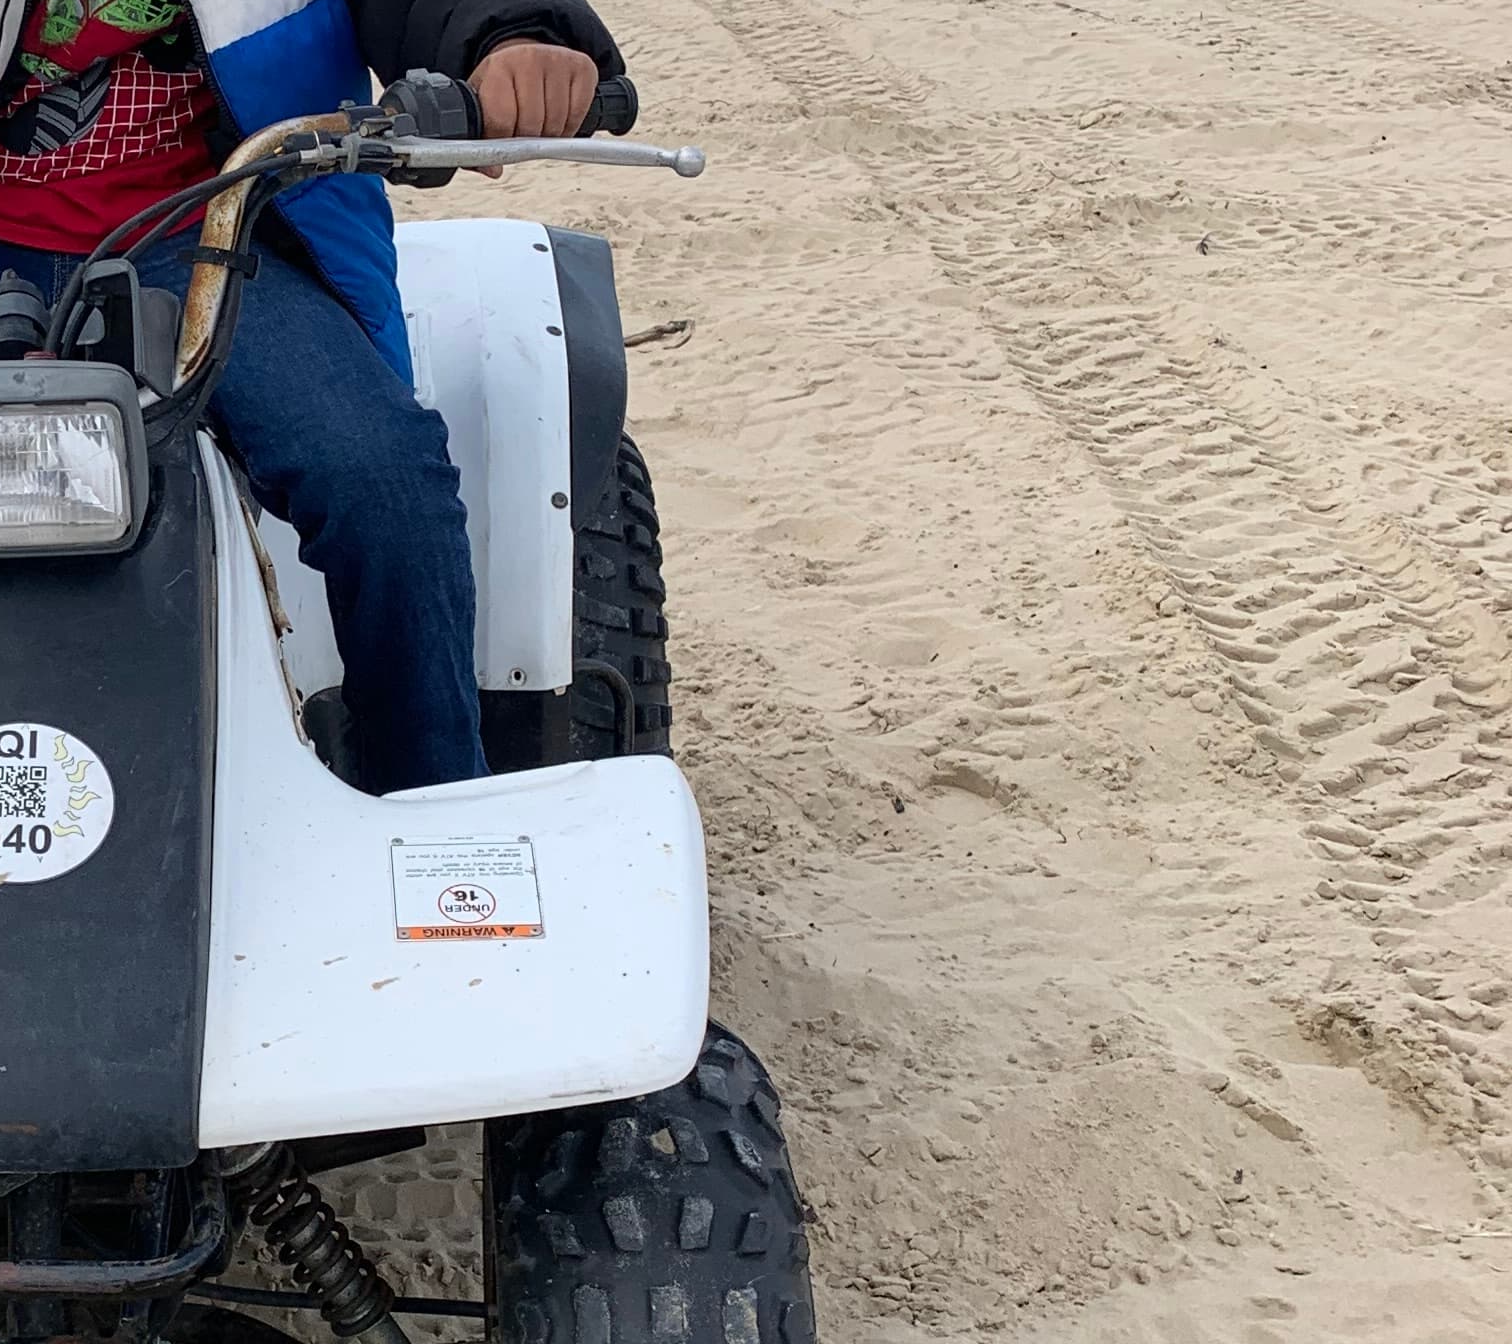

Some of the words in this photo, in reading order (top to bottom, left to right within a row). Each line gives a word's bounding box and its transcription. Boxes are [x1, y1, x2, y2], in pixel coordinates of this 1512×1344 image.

[454, 890, 479, 902] 16
[444, 903, 491, 913] UNDER
[422, 927, 496, 937] WARNING
